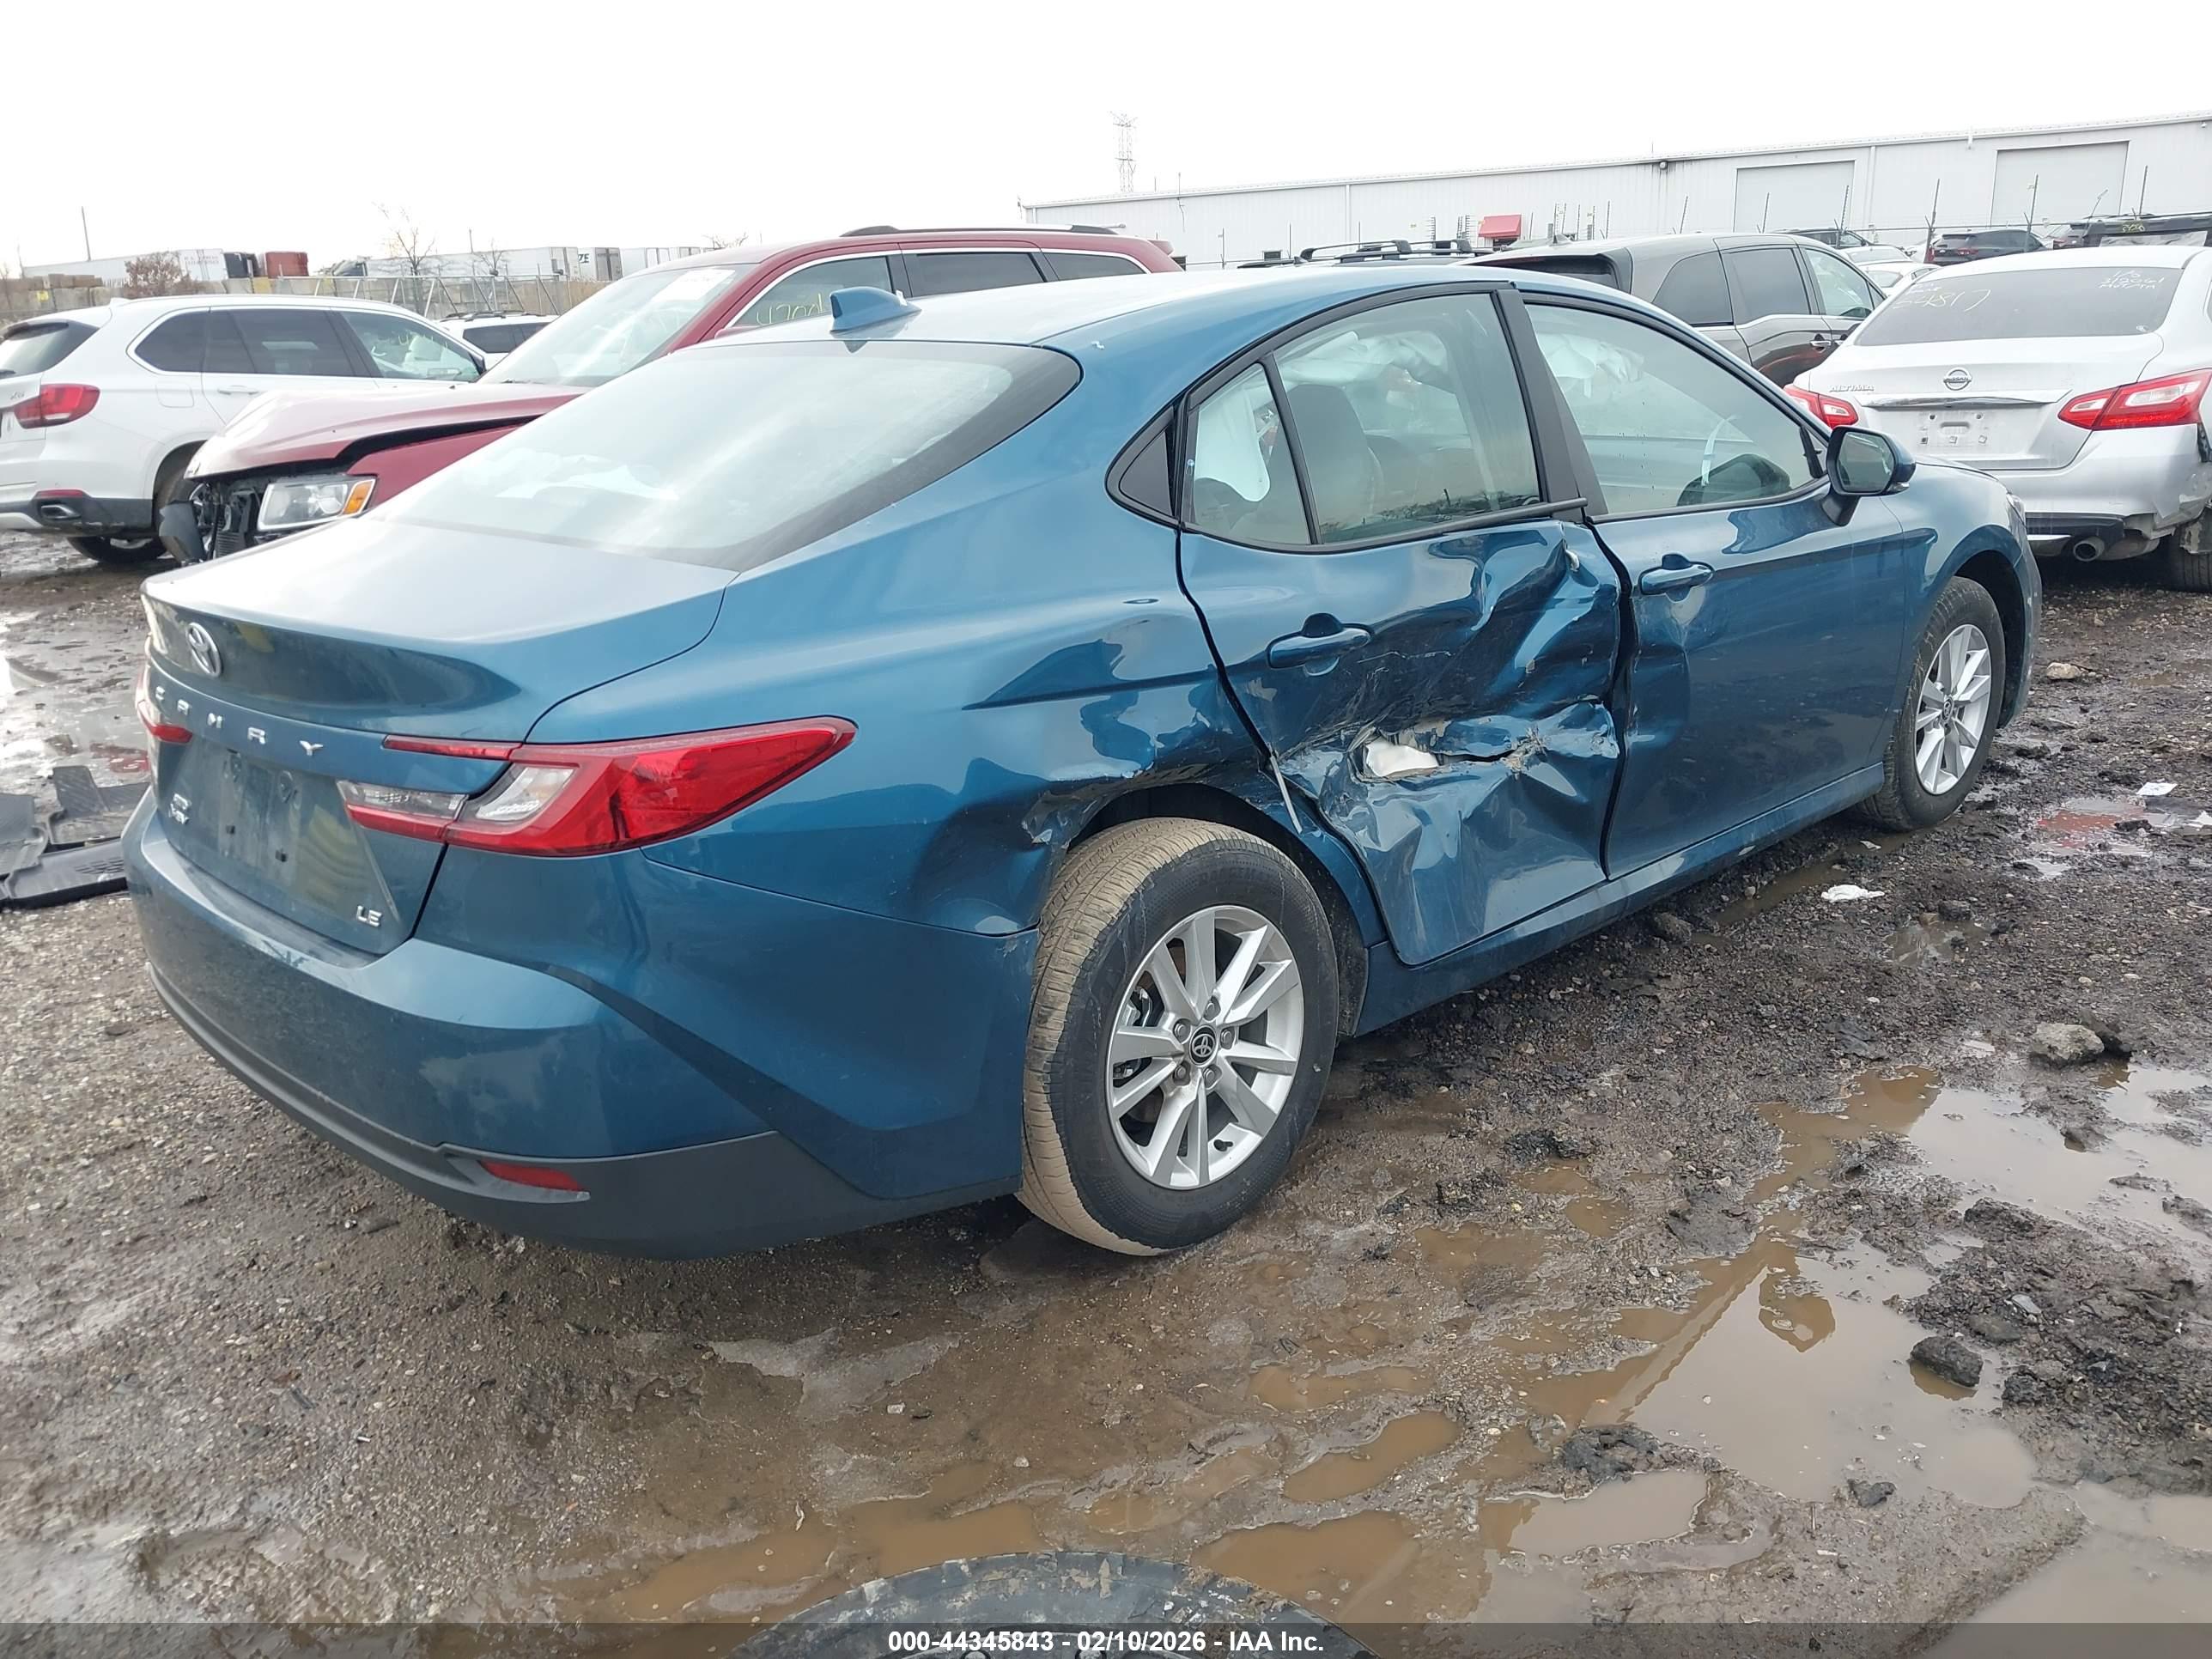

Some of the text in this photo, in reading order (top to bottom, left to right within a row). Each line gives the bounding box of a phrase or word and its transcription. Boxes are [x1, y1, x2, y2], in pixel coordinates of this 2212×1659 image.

[1829, 384, 1875, 393] ALTIMA
[155, 686, 323, 757] CAMRY
[356, 905, 382, 927] LE
